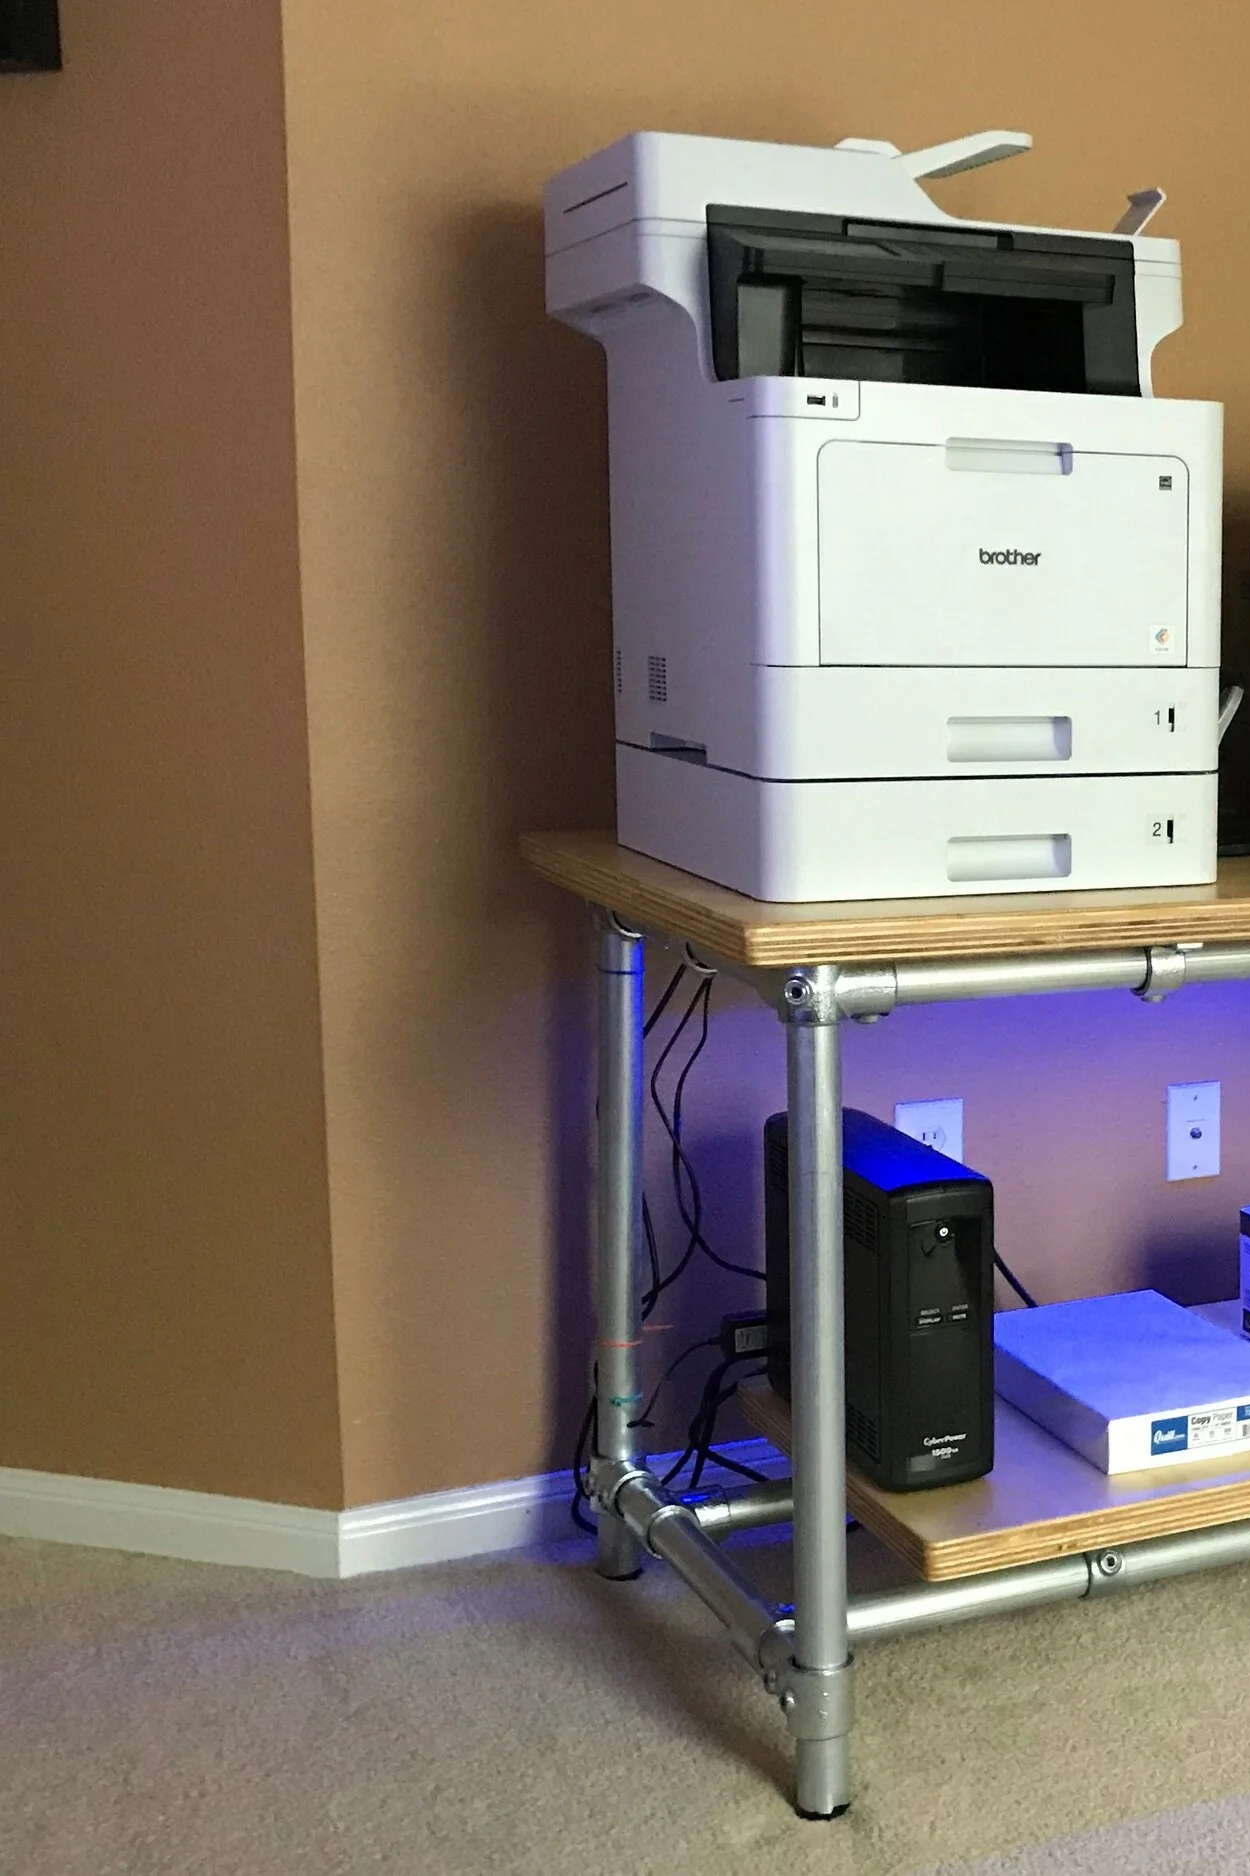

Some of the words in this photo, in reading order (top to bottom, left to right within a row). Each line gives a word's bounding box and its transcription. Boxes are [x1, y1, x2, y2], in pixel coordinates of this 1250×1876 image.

[979, 548, 1042, 566] brother
[1154, 710, 1161, 725] 1
[1152, 822, 1162, 837] 2
[1191, 1416, 1211, 1426] Copy
